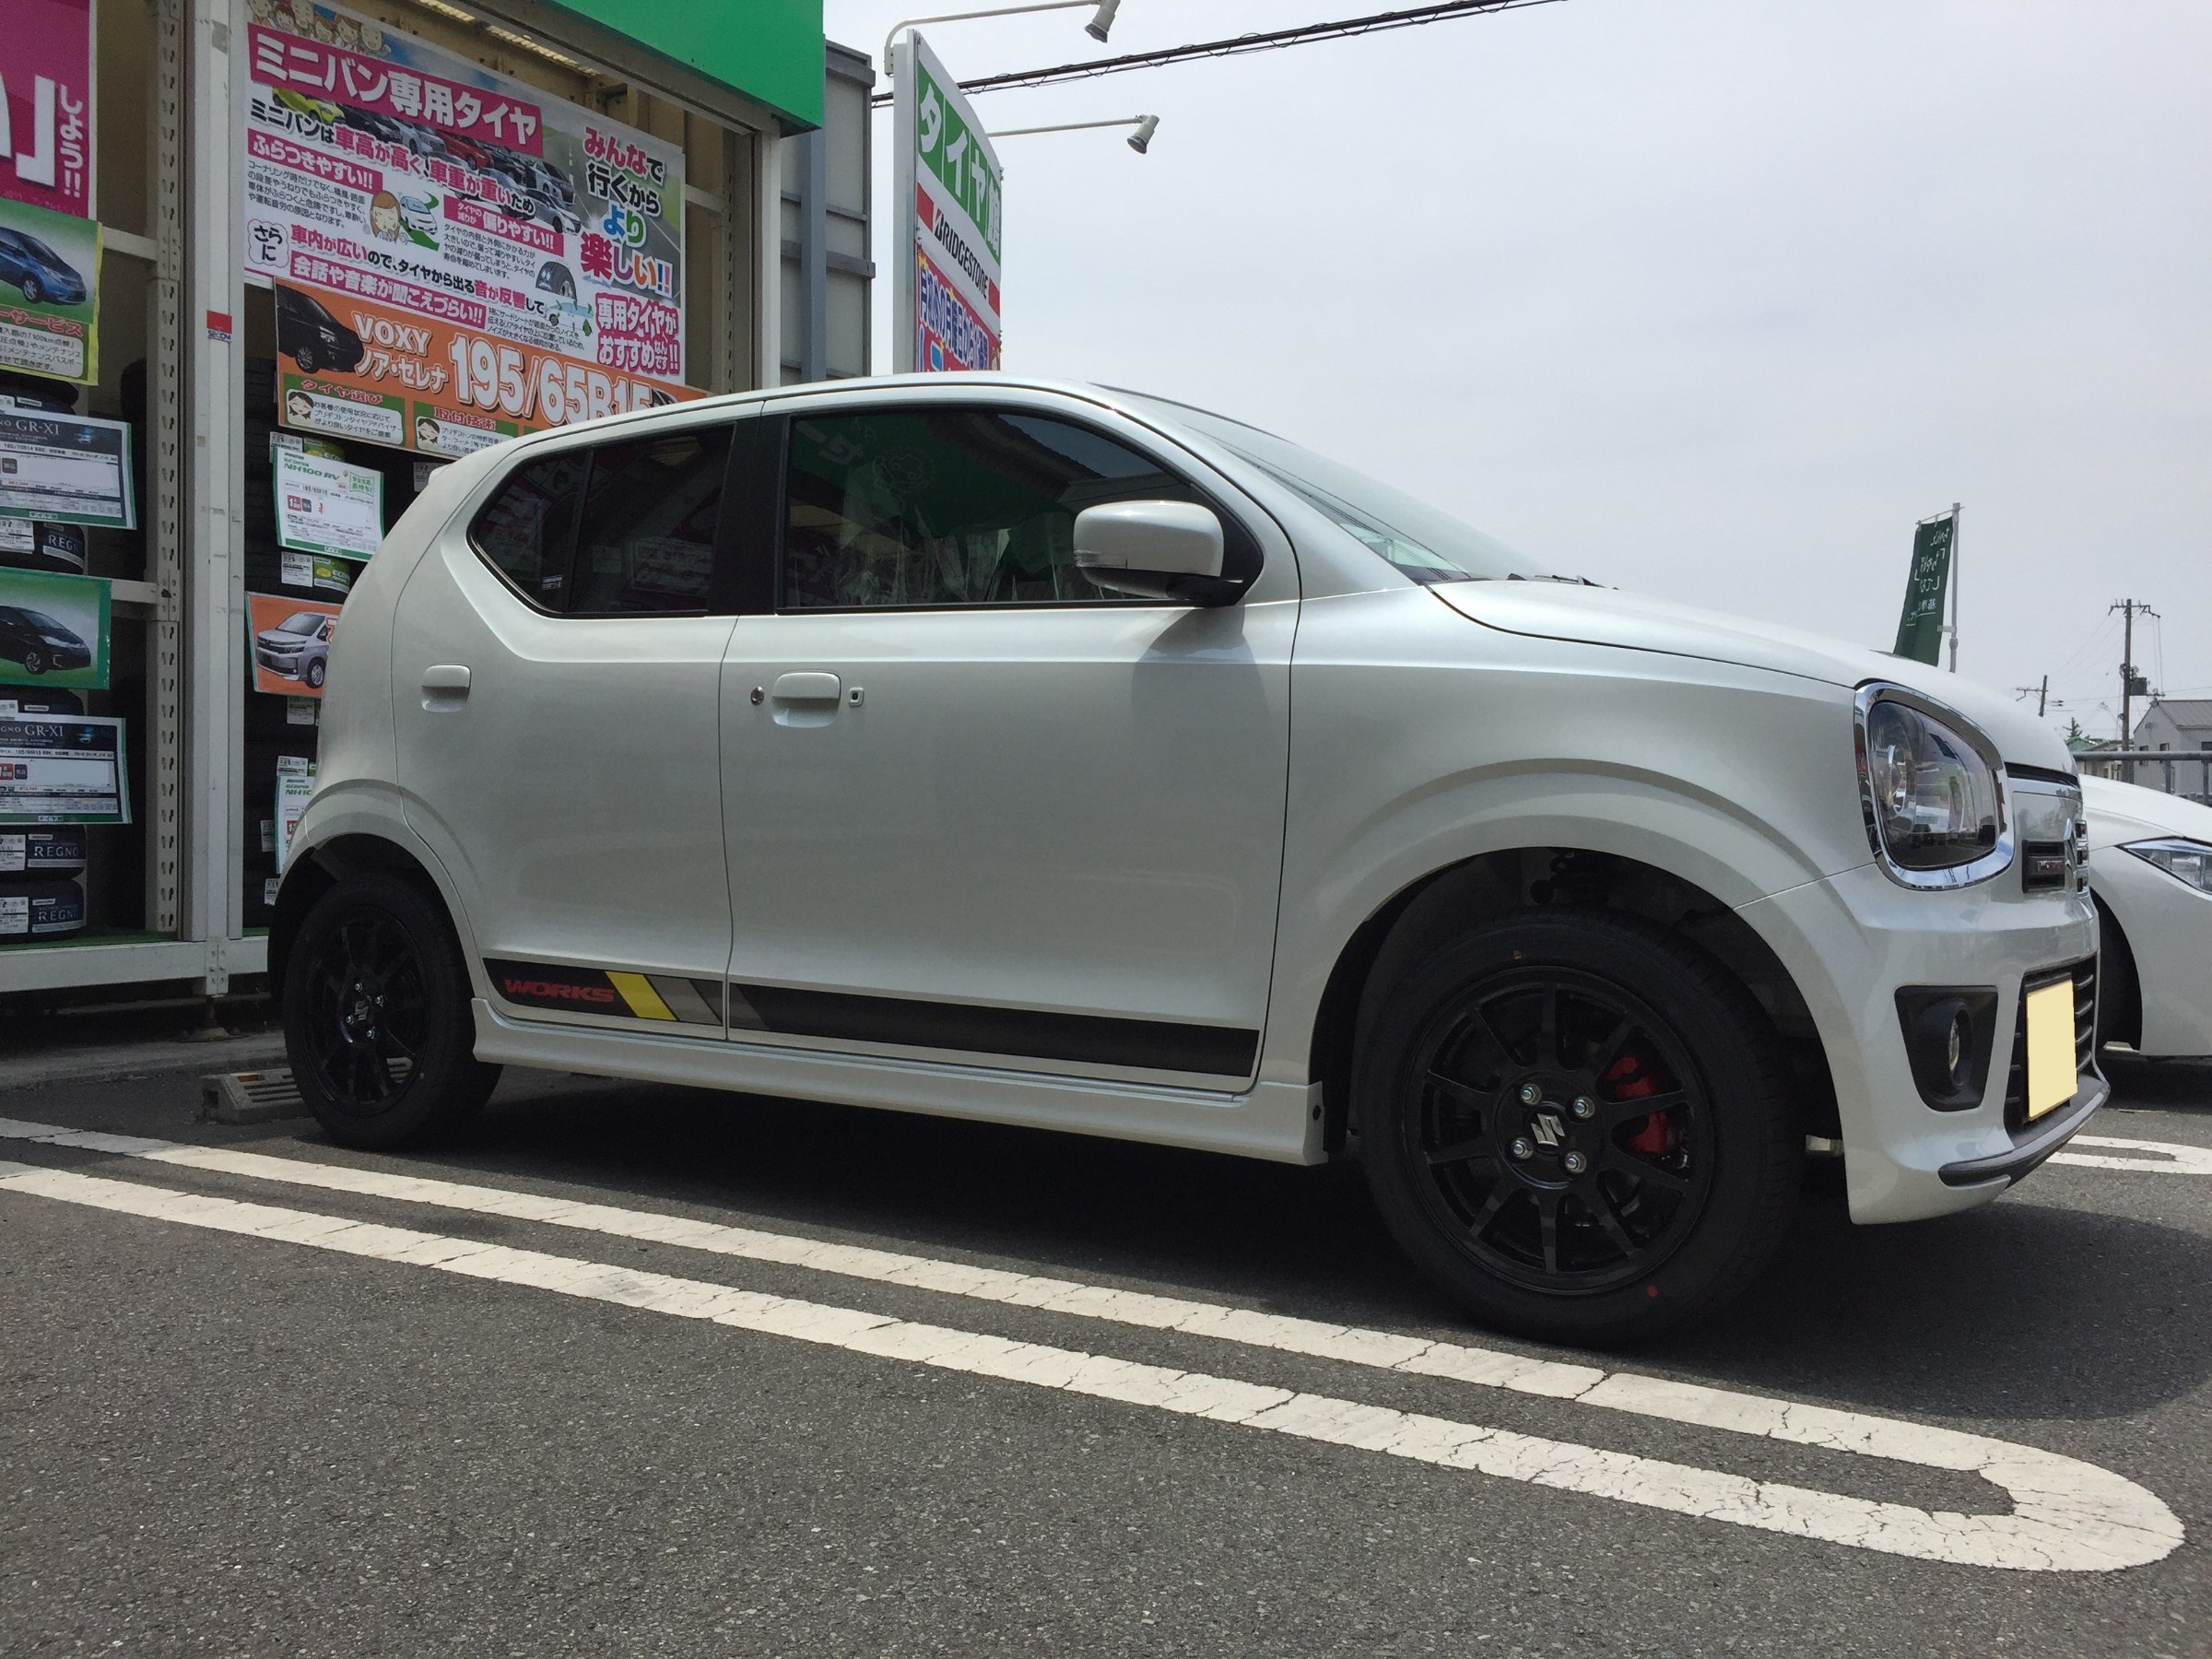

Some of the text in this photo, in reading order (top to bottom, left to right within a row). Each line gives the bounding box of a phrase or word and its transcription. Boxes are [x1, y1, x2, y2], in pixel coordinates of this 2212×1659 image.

[254, 34, 537, 147] ミニバン専用タイヤ
[253, 134, 373, 190] ふらつきやすい!!
[584, 126, 665, 183] みんなで
[586, 161, 661, 217] 行くから
[603, 205, 646, 247] より
[579, 230, 674, 296] 楽しい!!
[934, 207, 989, 300] BRIDGESTONE
[293, 255, 484, 324] 会話や音楽が聞こえづらい!!
[351, 312, 433, 355] VOXY
[598, 298, 677, 337] 専用タイヤが
[300, 378, 383, 405] タイヤ選び
[354, 349, 451, 394] ノア・セレナ
[16, 419, 60, 436] GR-XI
[433, 406, 497, 431] 取付技術
[284, 463, 323, 477] NH100
[324, 471, 341, 481] RV
[25, 724, 64, 737] GR-XI
[503, 979, 616, 1004] WORKS
